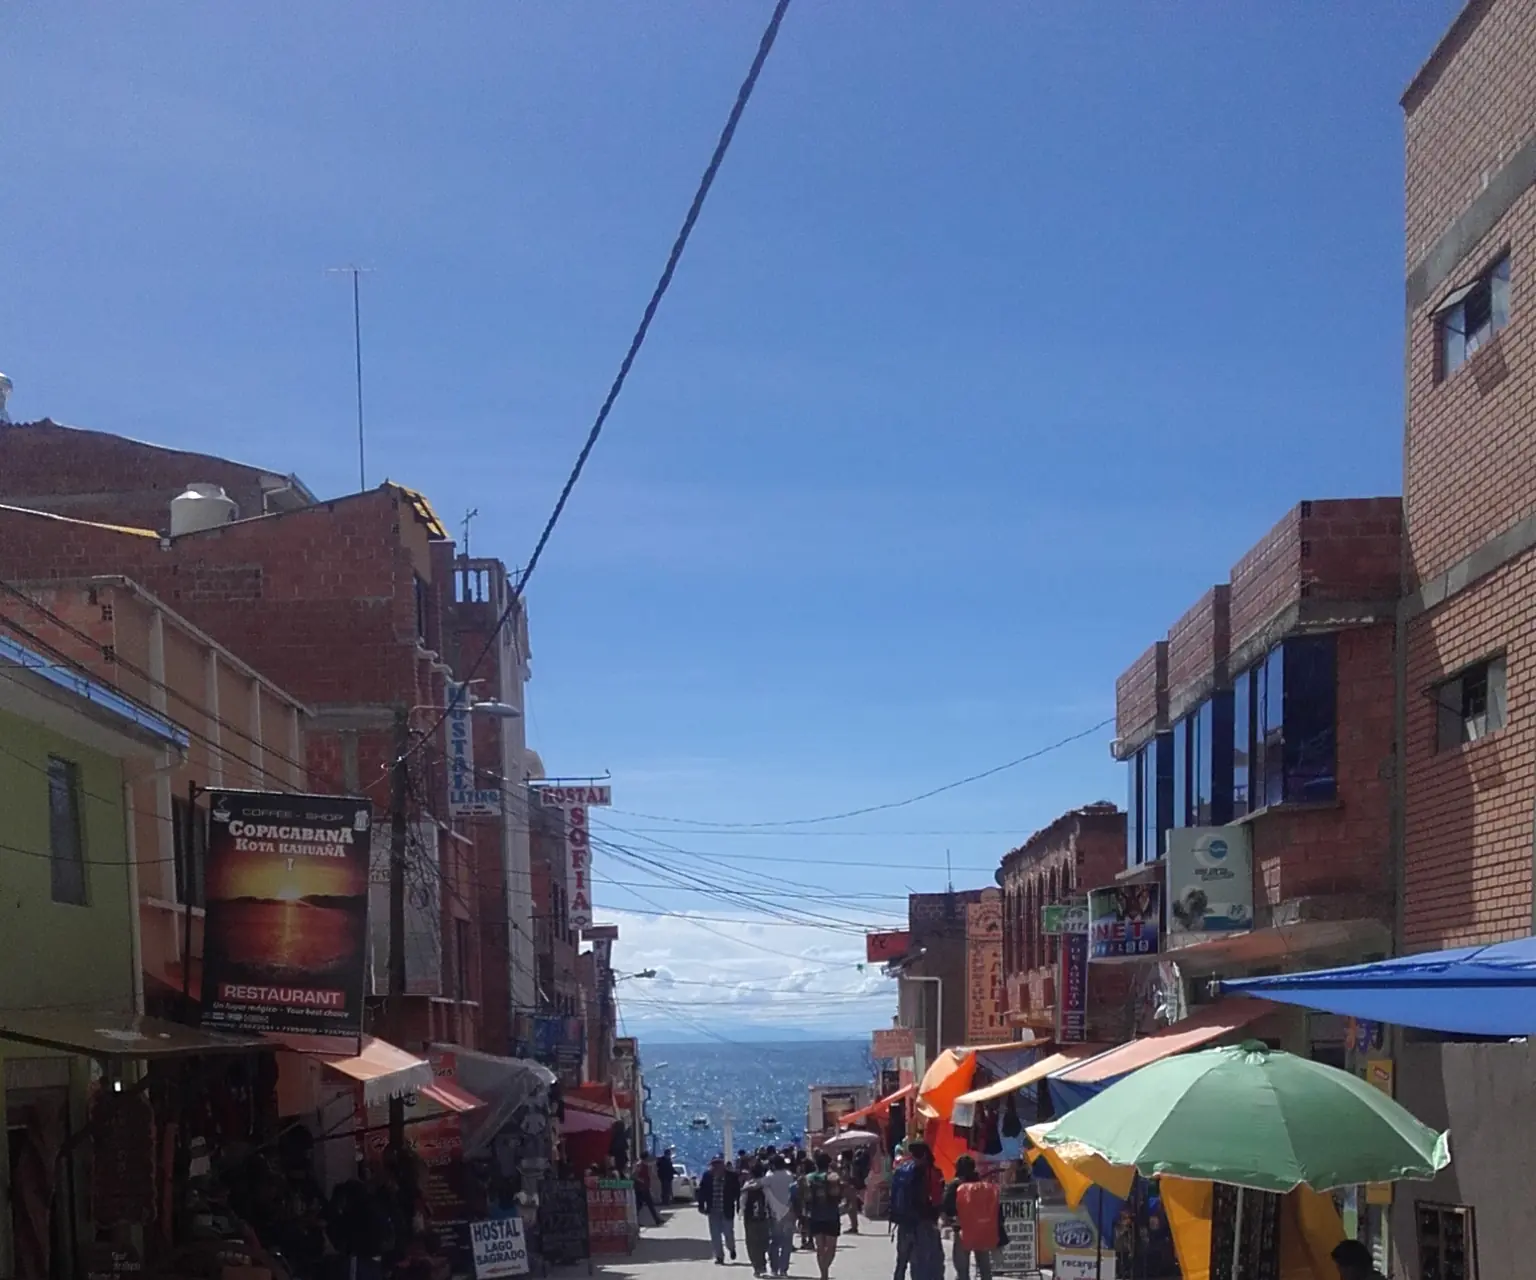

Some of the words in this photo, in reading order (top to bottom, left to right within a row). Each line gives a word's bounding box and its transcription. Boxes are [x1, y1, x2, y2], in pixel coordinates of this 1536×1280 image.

[542, 787, 608, 804] HOSTAL
[242, 808, 292, 819] COFFEE
[305, 812, 344, 822] SHOP
[228, 820, 354, 844] COPACABANA
[236, 838, 275, 853] KOTA
[569, 807, 590, 911] SOFIA
[224, 985, 340, 1005] RESTAURANT
[1000, 1202, 1032, 1218] RNET
[474, 1219, 520, 1242] HOSTAL
[484, 1241, 513, 1253] LAGO
[476, 1250, 525, 1265] SAGRADO
